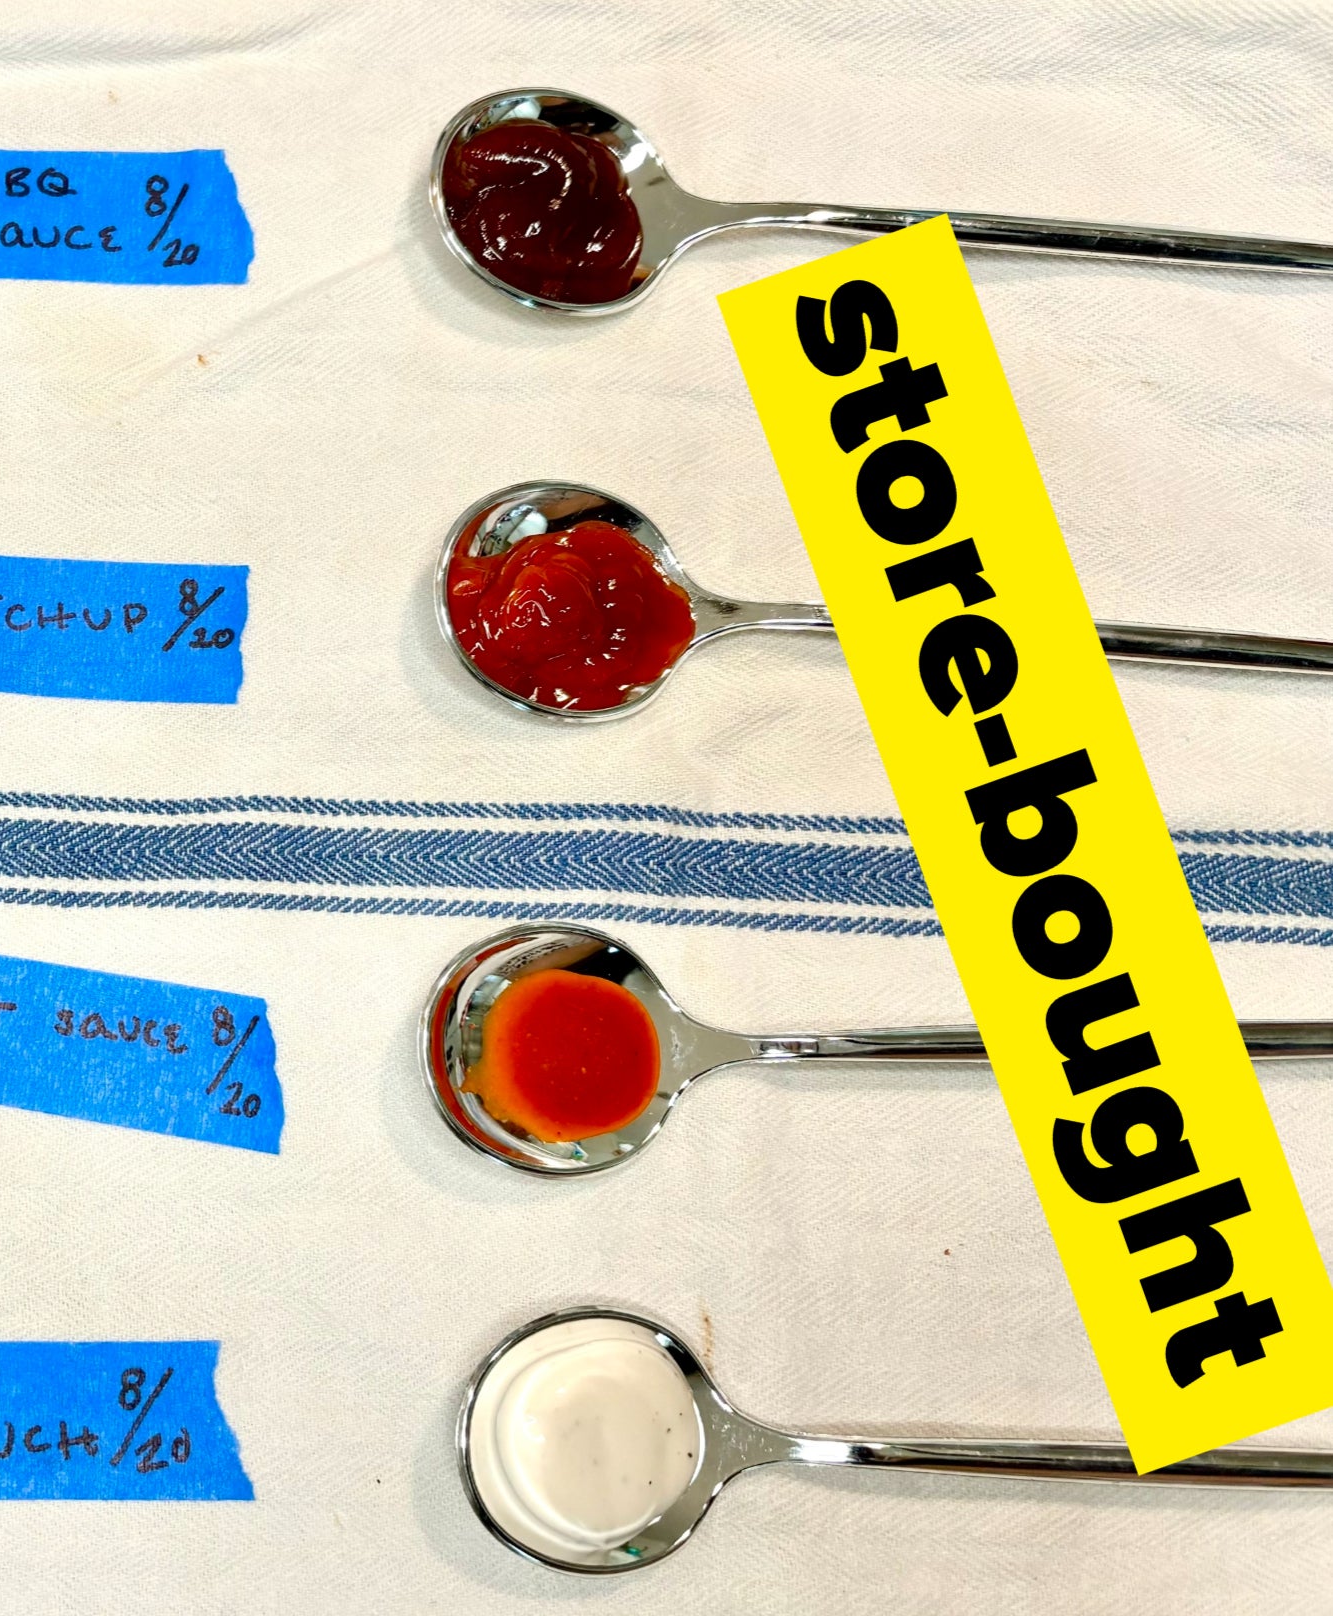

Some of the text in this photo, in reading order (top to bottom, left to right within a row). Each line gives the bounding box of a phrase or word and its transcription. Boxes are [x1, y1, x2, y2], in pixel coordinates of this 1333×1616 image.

[144, 174, 201, 268] 8/20
[161, 577, 236, 653] 8/20
[204, 1005, 262, 1119] 8/20
[110, 1367, 192, 1474] 8/20
